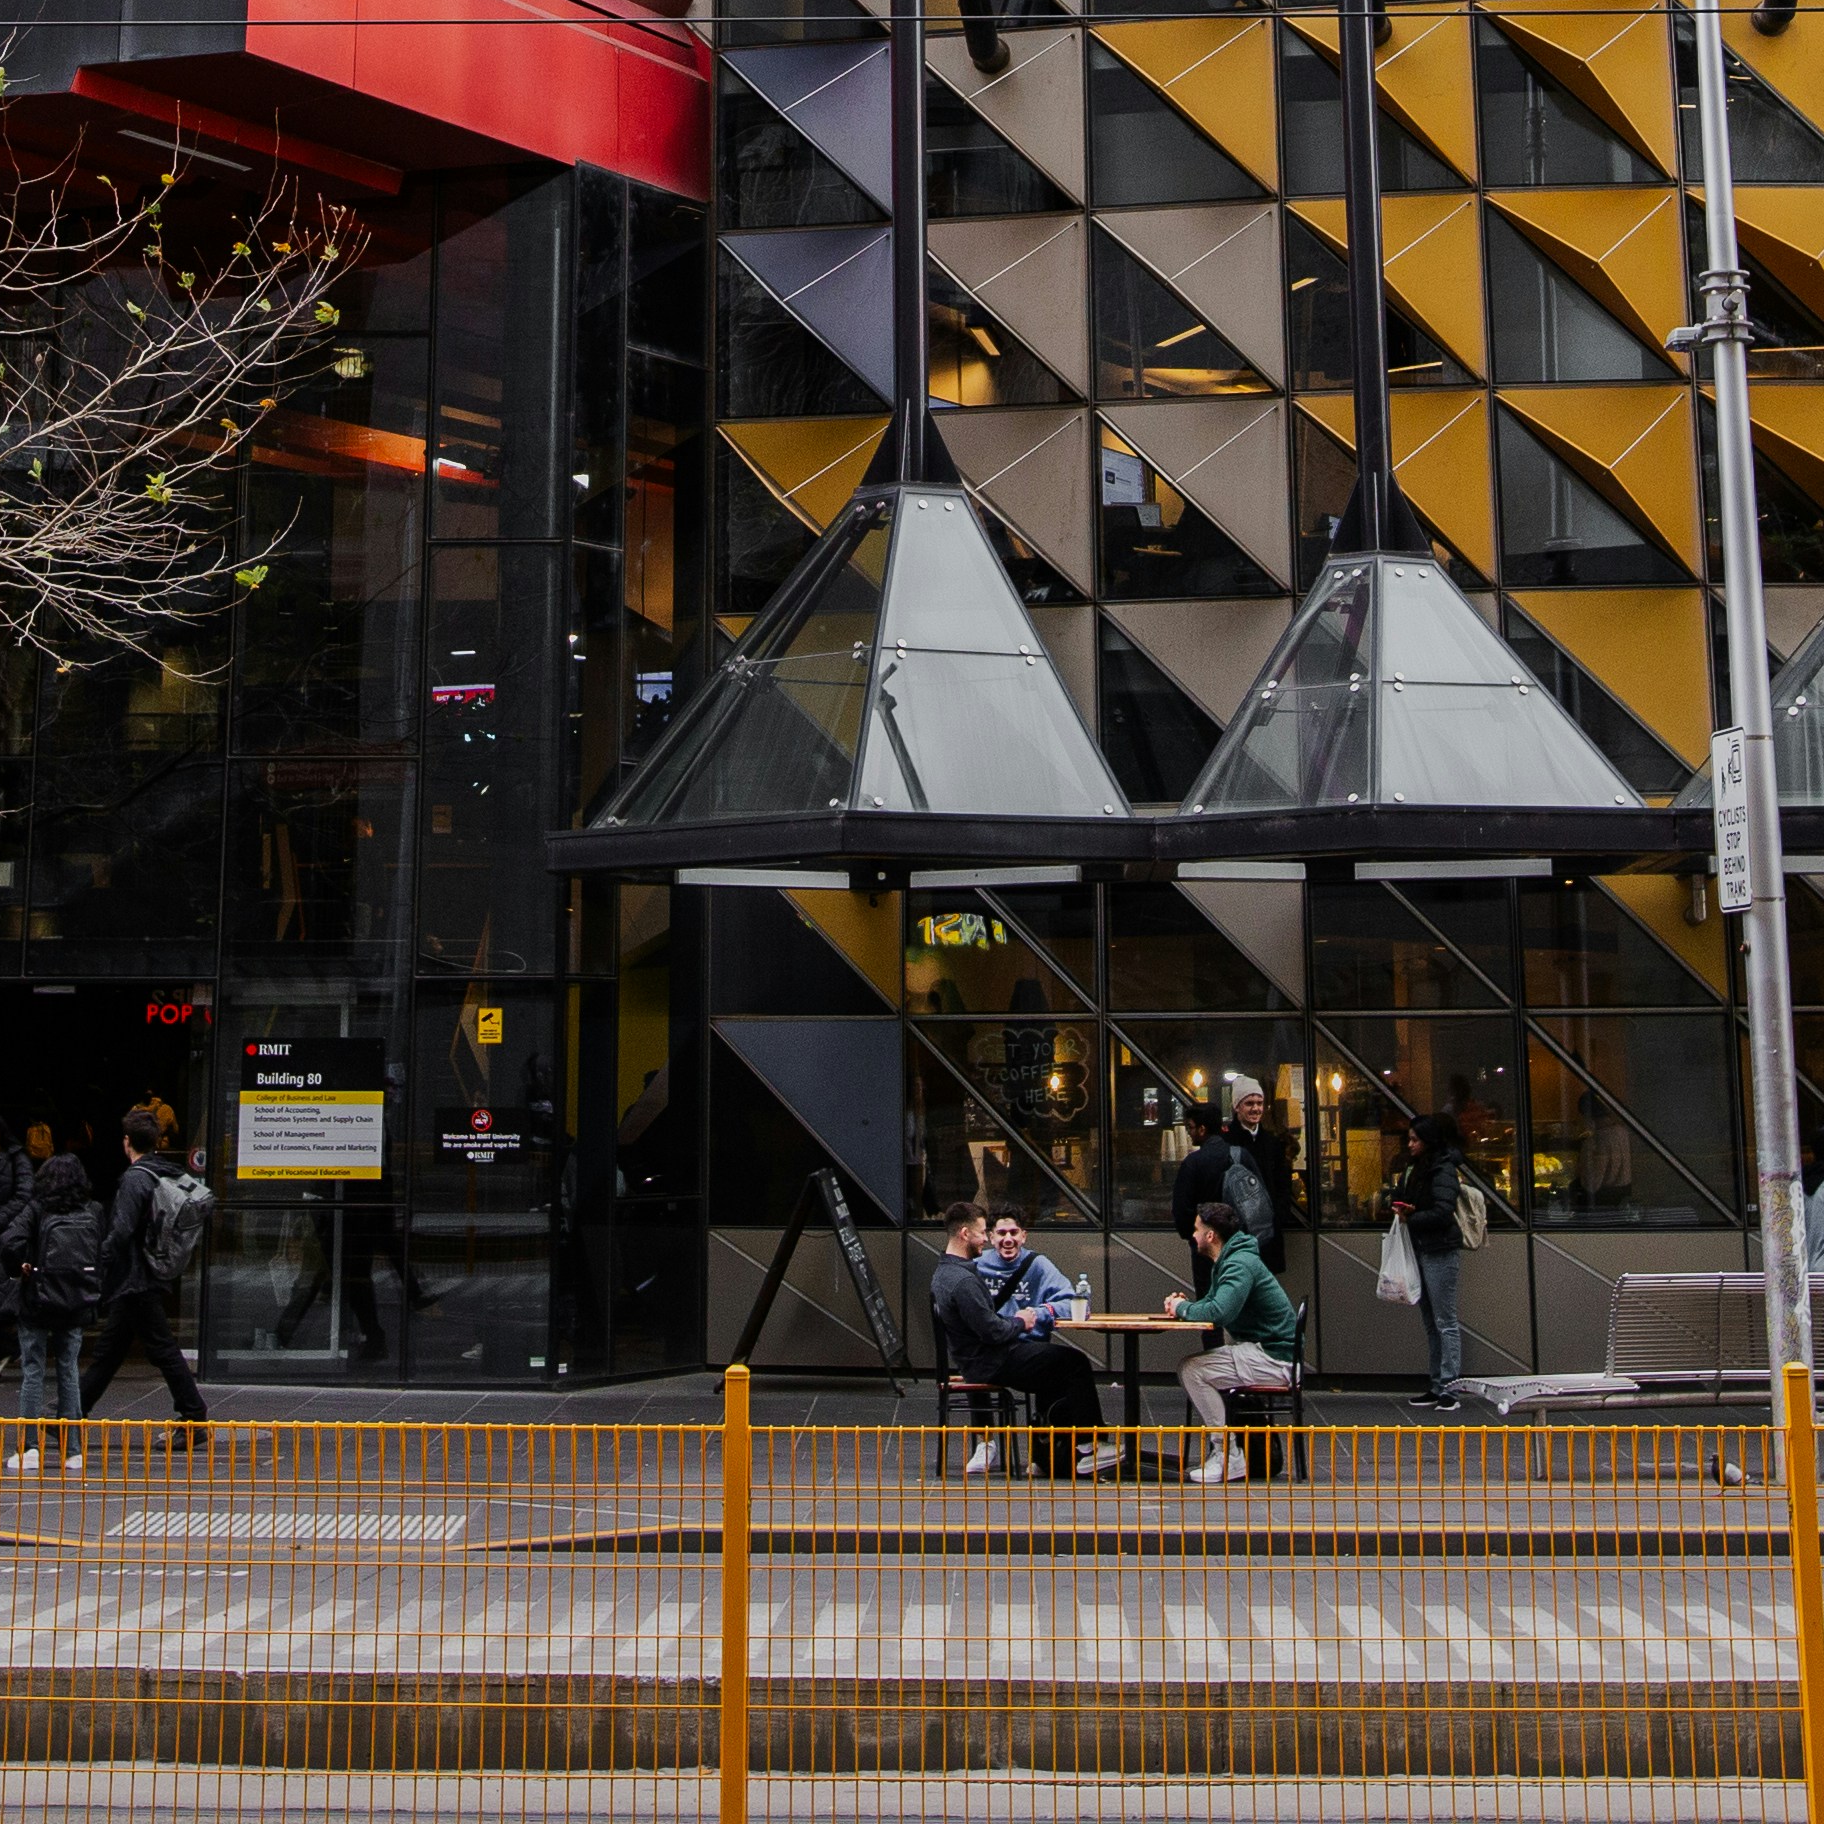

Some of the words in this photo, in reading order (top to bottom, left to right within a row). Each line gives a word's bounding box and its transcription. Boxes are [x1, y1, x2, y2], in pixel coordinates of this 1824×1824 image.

[1718, 805, 1746, 828] CYCLISTS
[1726, 830, 1741, 851] STOP
[1723, 855, 1746, 875] BEHIND
[1726, 879, 1746, 899] TRAMS
[146, 1002, 193, 1025] POP
[258, 1044, 292, 1055] RMIT
[256, 1072, 304, 1088] Building
[307, 1073, 322, 1085] 80
[999, 1062, 1066, 1082] COFFEE
[256, 1094, 277, 1102] College
[1025, 1085, 1070, 1104] HERE
[292, 1116, 318, 1124] Systems
[333, 1116, 354, 1124] Supply
[348, 1144, 377, 1152] Marketing
[475, 1151, 496, 1160] RMIT
[252, 1169, 275, 1177] College
